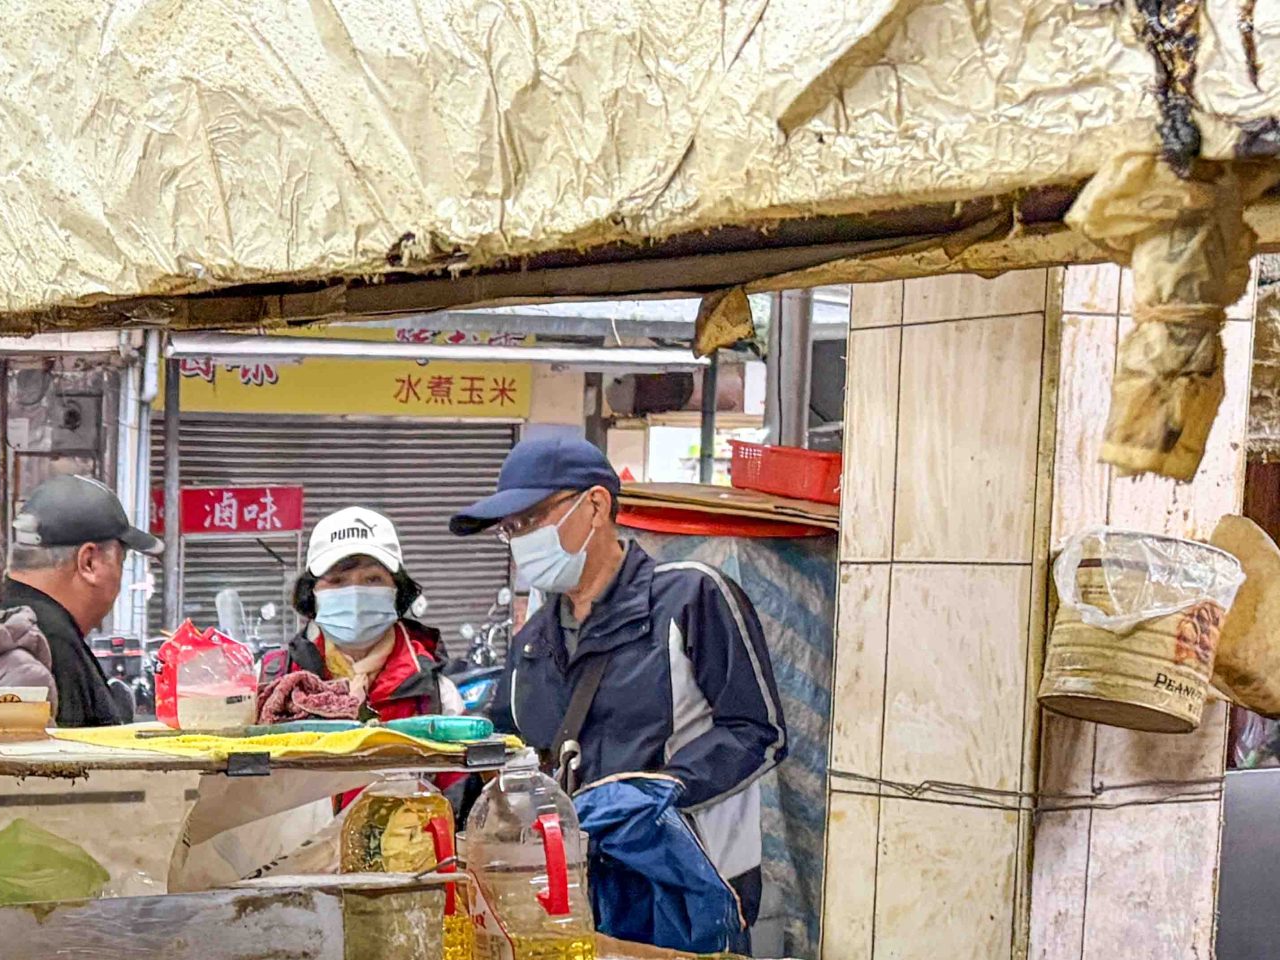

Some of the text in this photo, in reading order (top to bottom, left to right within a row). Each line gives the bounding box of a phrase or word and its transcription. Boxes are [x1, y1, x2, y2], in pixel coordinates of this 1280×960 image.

[393, 373, 517, 406] 水煮玉米
[203, 487, 282, 530] 滷味
[330, 527, 368, 543] PUMA
